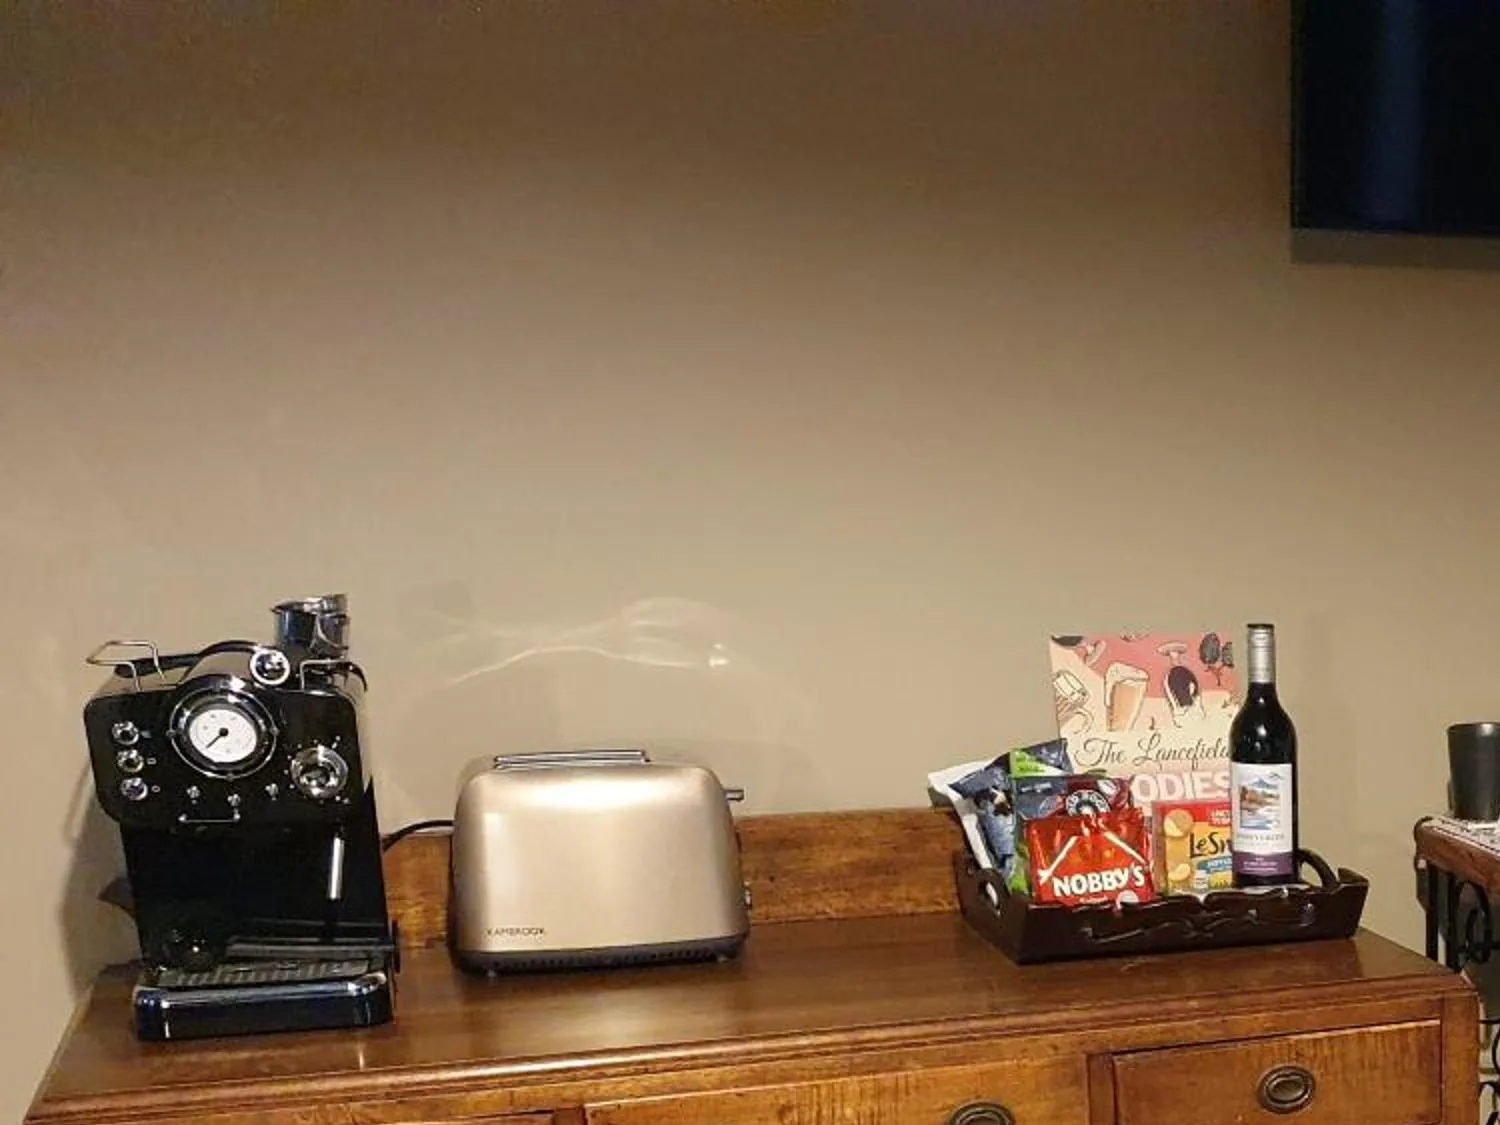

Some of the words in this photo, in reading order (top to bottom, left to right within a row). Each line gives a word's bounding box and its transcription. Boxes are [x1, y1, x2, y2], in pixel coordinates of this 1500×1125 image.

[1074, 737, 1126, 767] The
[1129, 771, 1230, 802] ODIES
[1052, 862, 1146, 897] NOBBY'S
